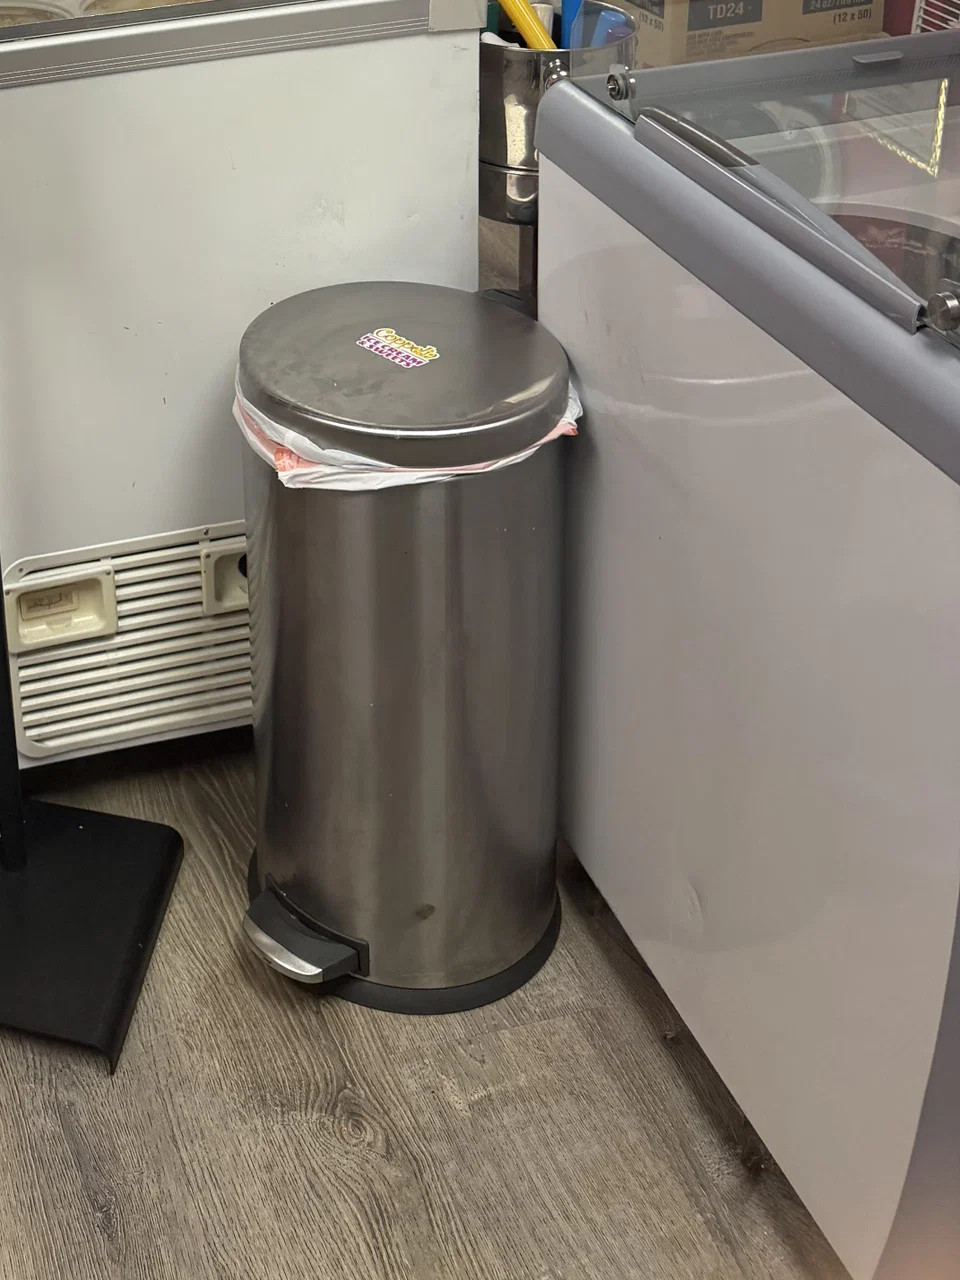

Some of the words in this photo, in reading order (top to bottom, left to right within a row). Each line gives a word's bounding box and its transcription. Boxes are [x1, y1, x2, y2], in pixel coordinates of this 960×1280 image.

[708, 2, 744, 20] TD24
[810, 0, 821, 10] 24
[849, 13, 856, 21] x
[375, 328, 438, 359] Coppelia
